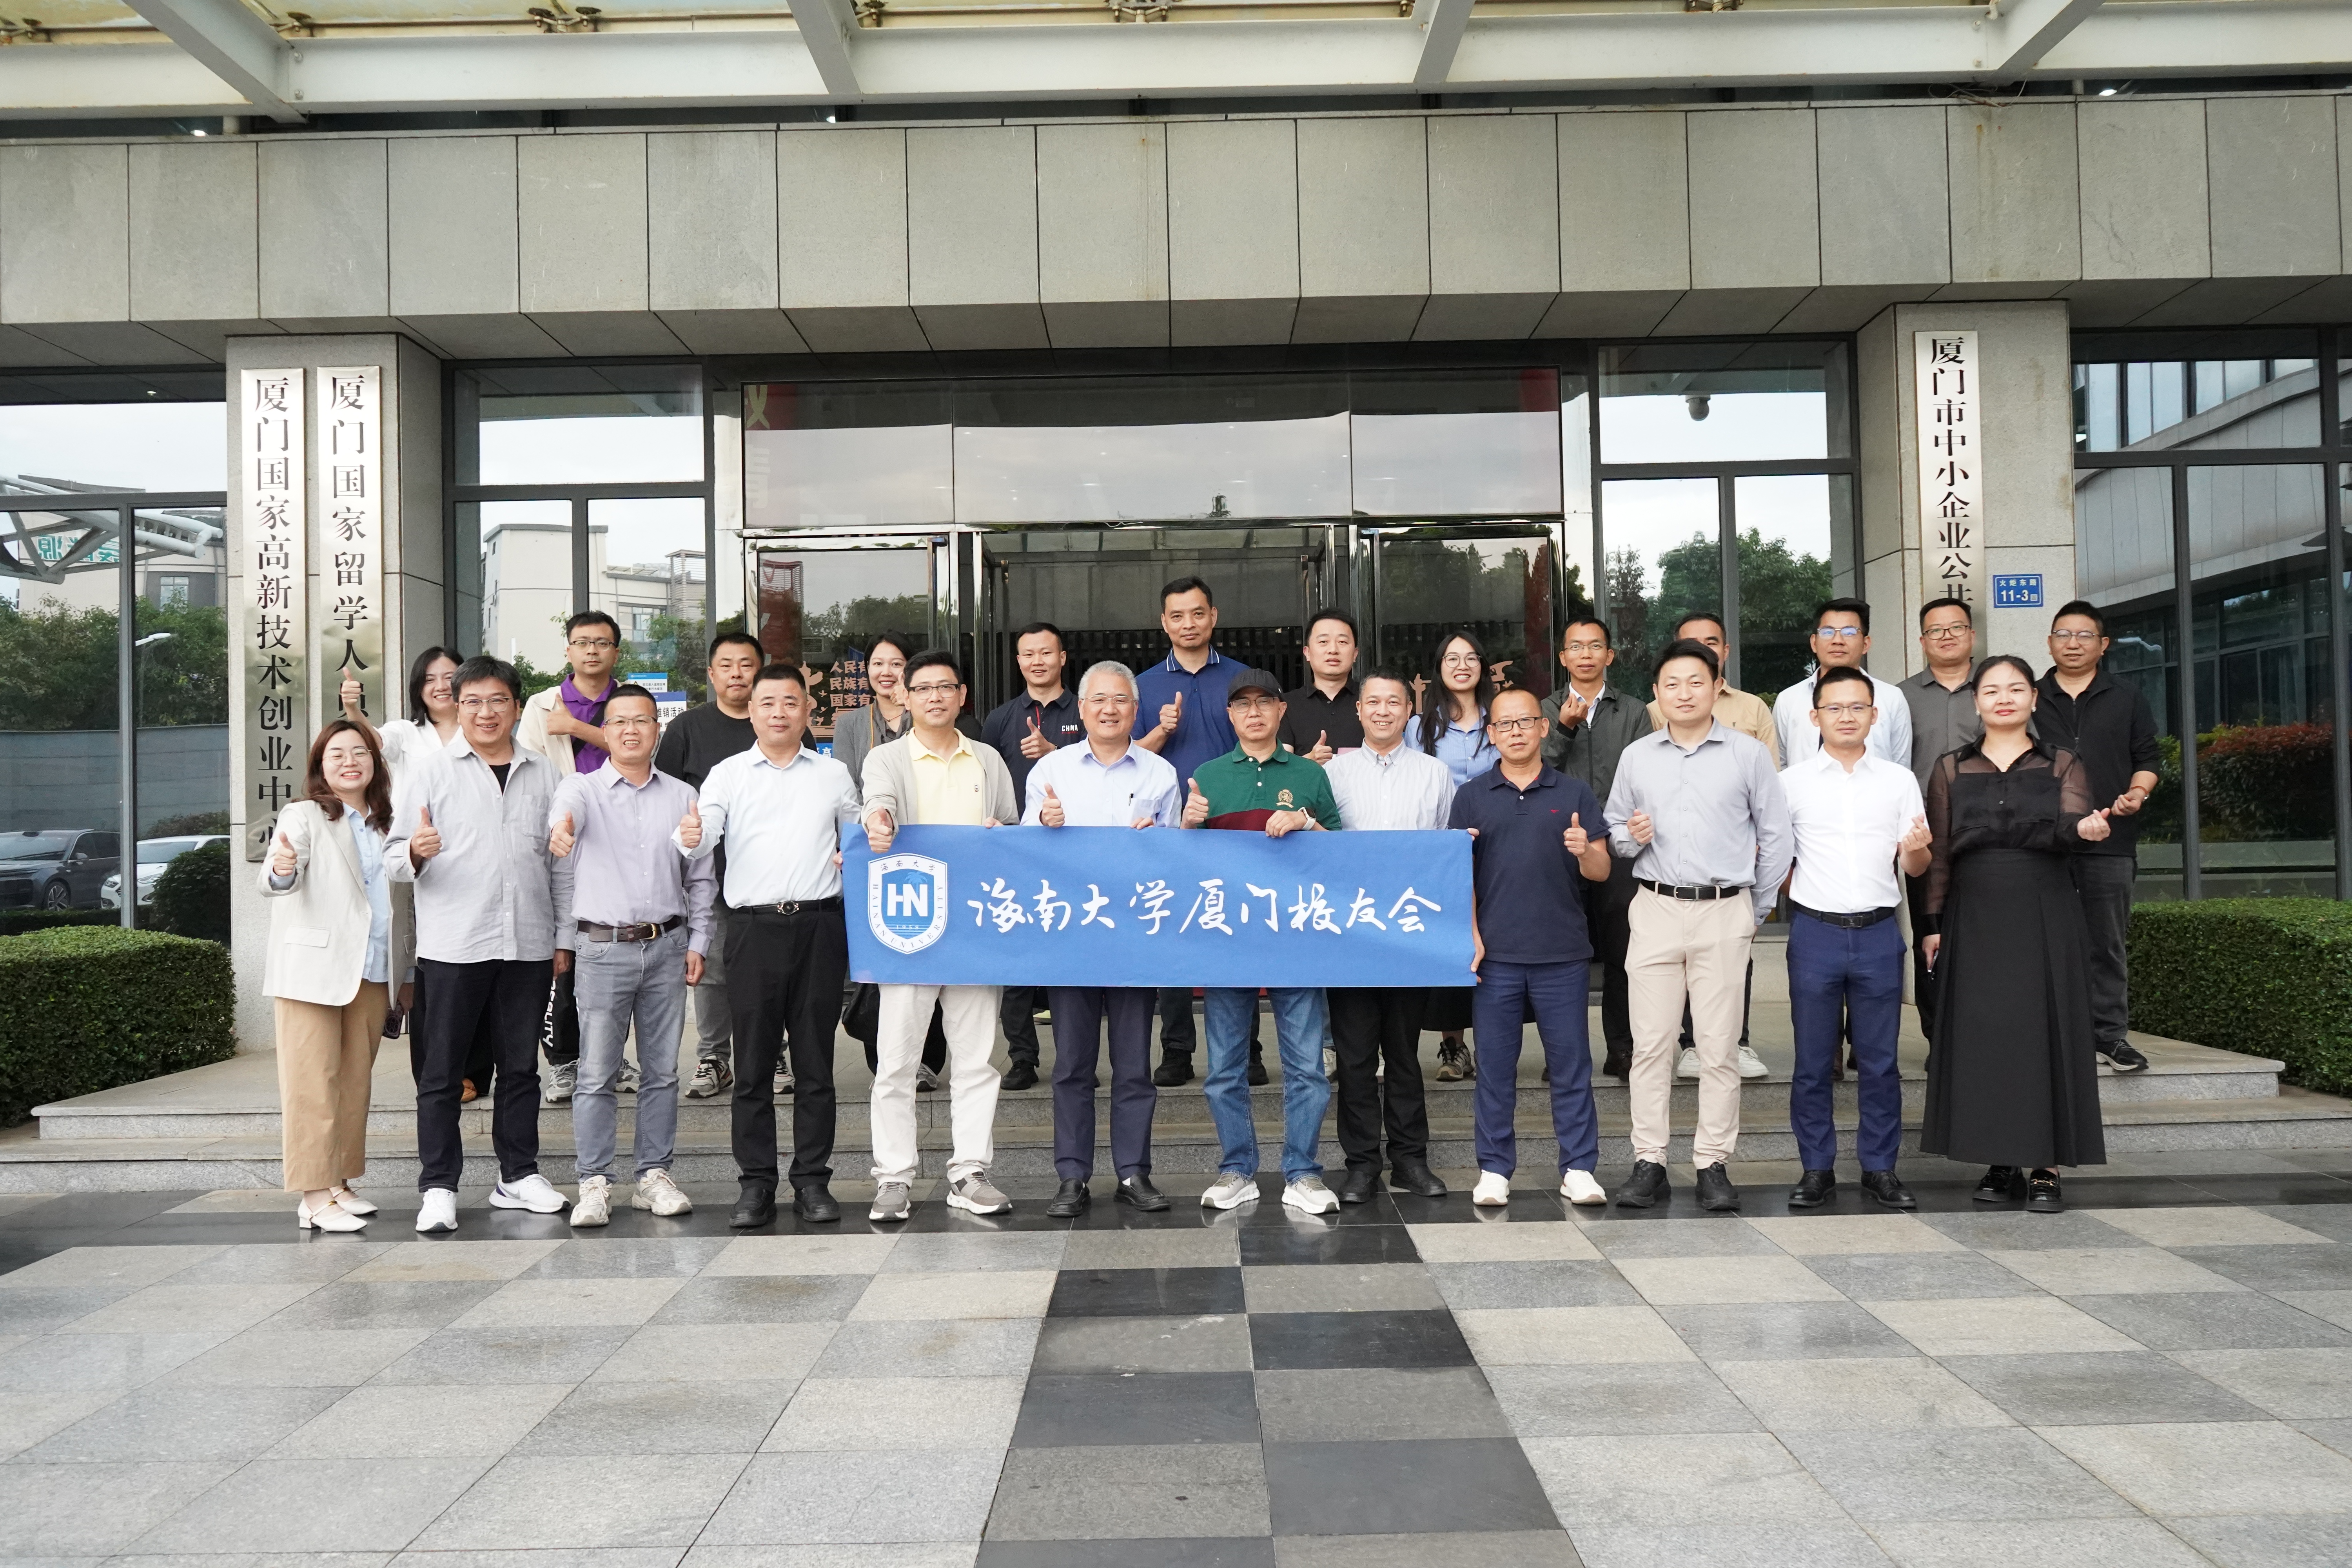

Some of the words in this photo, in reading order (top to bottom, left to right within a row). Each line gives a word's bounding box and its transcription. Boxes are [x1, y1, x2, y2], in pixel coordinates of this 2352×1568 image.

[2001, 590, 2028, 601] 11-3
[830, 677, 869, 690] 民族有
[830, 693, 876, 707] 国家有
[880, 860, 935, 871] 海南大学
[887, 884, 928, 916] HN
[967, 878, 1441, 935] 海南大学厦门校友会
[873, 884, 887, 936] HAINAN
[891, 886, 943, 948] UNIVERSITY
